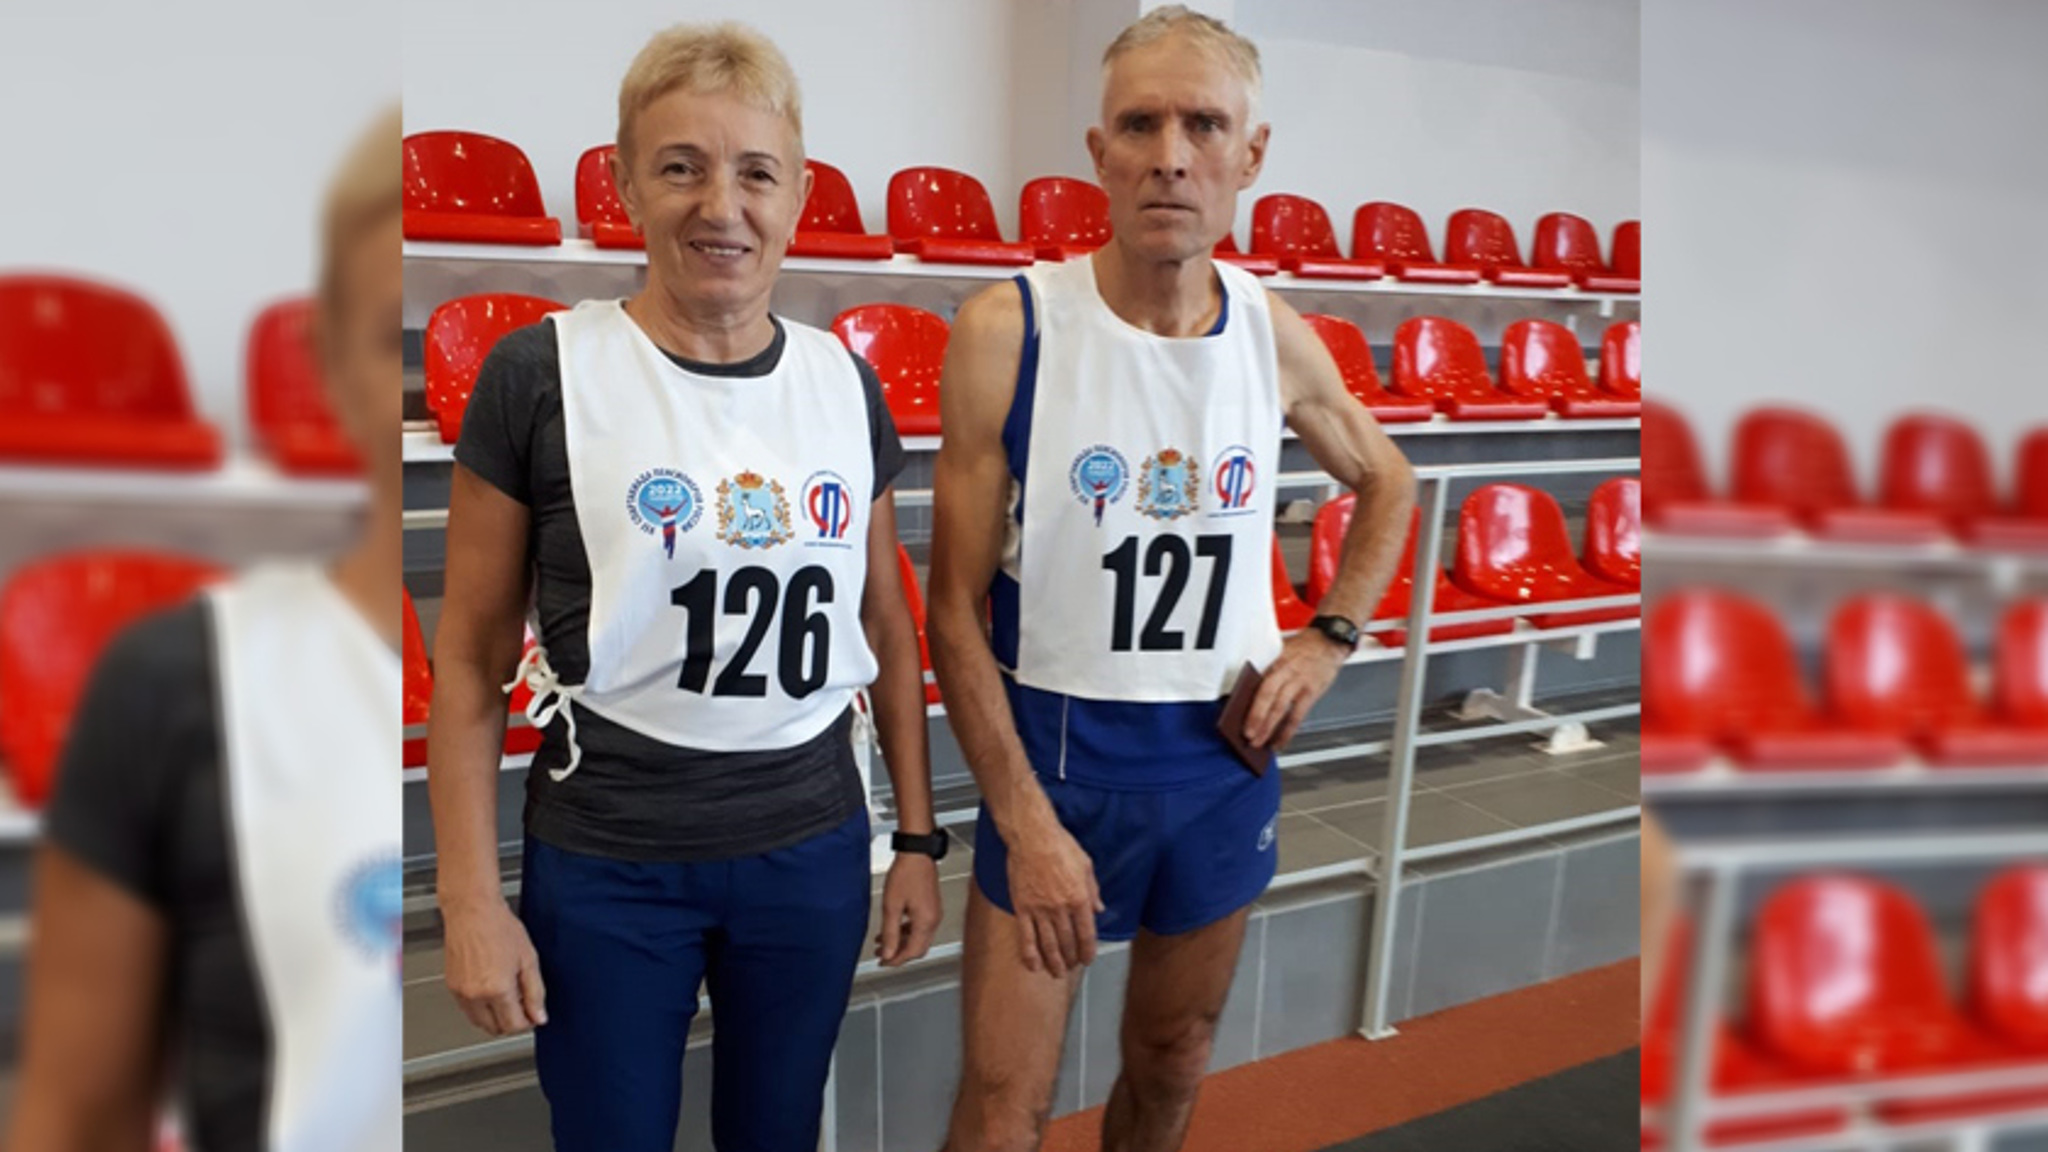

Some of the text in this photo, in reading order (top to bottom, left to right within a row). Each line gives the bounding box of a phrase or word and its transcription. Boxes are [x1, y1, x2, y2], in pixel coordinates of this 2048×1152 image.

[648, 484, 682, 496] 2022
[671, 565, 835, 701] 126
[1101, 533, 1233, 652] 127
